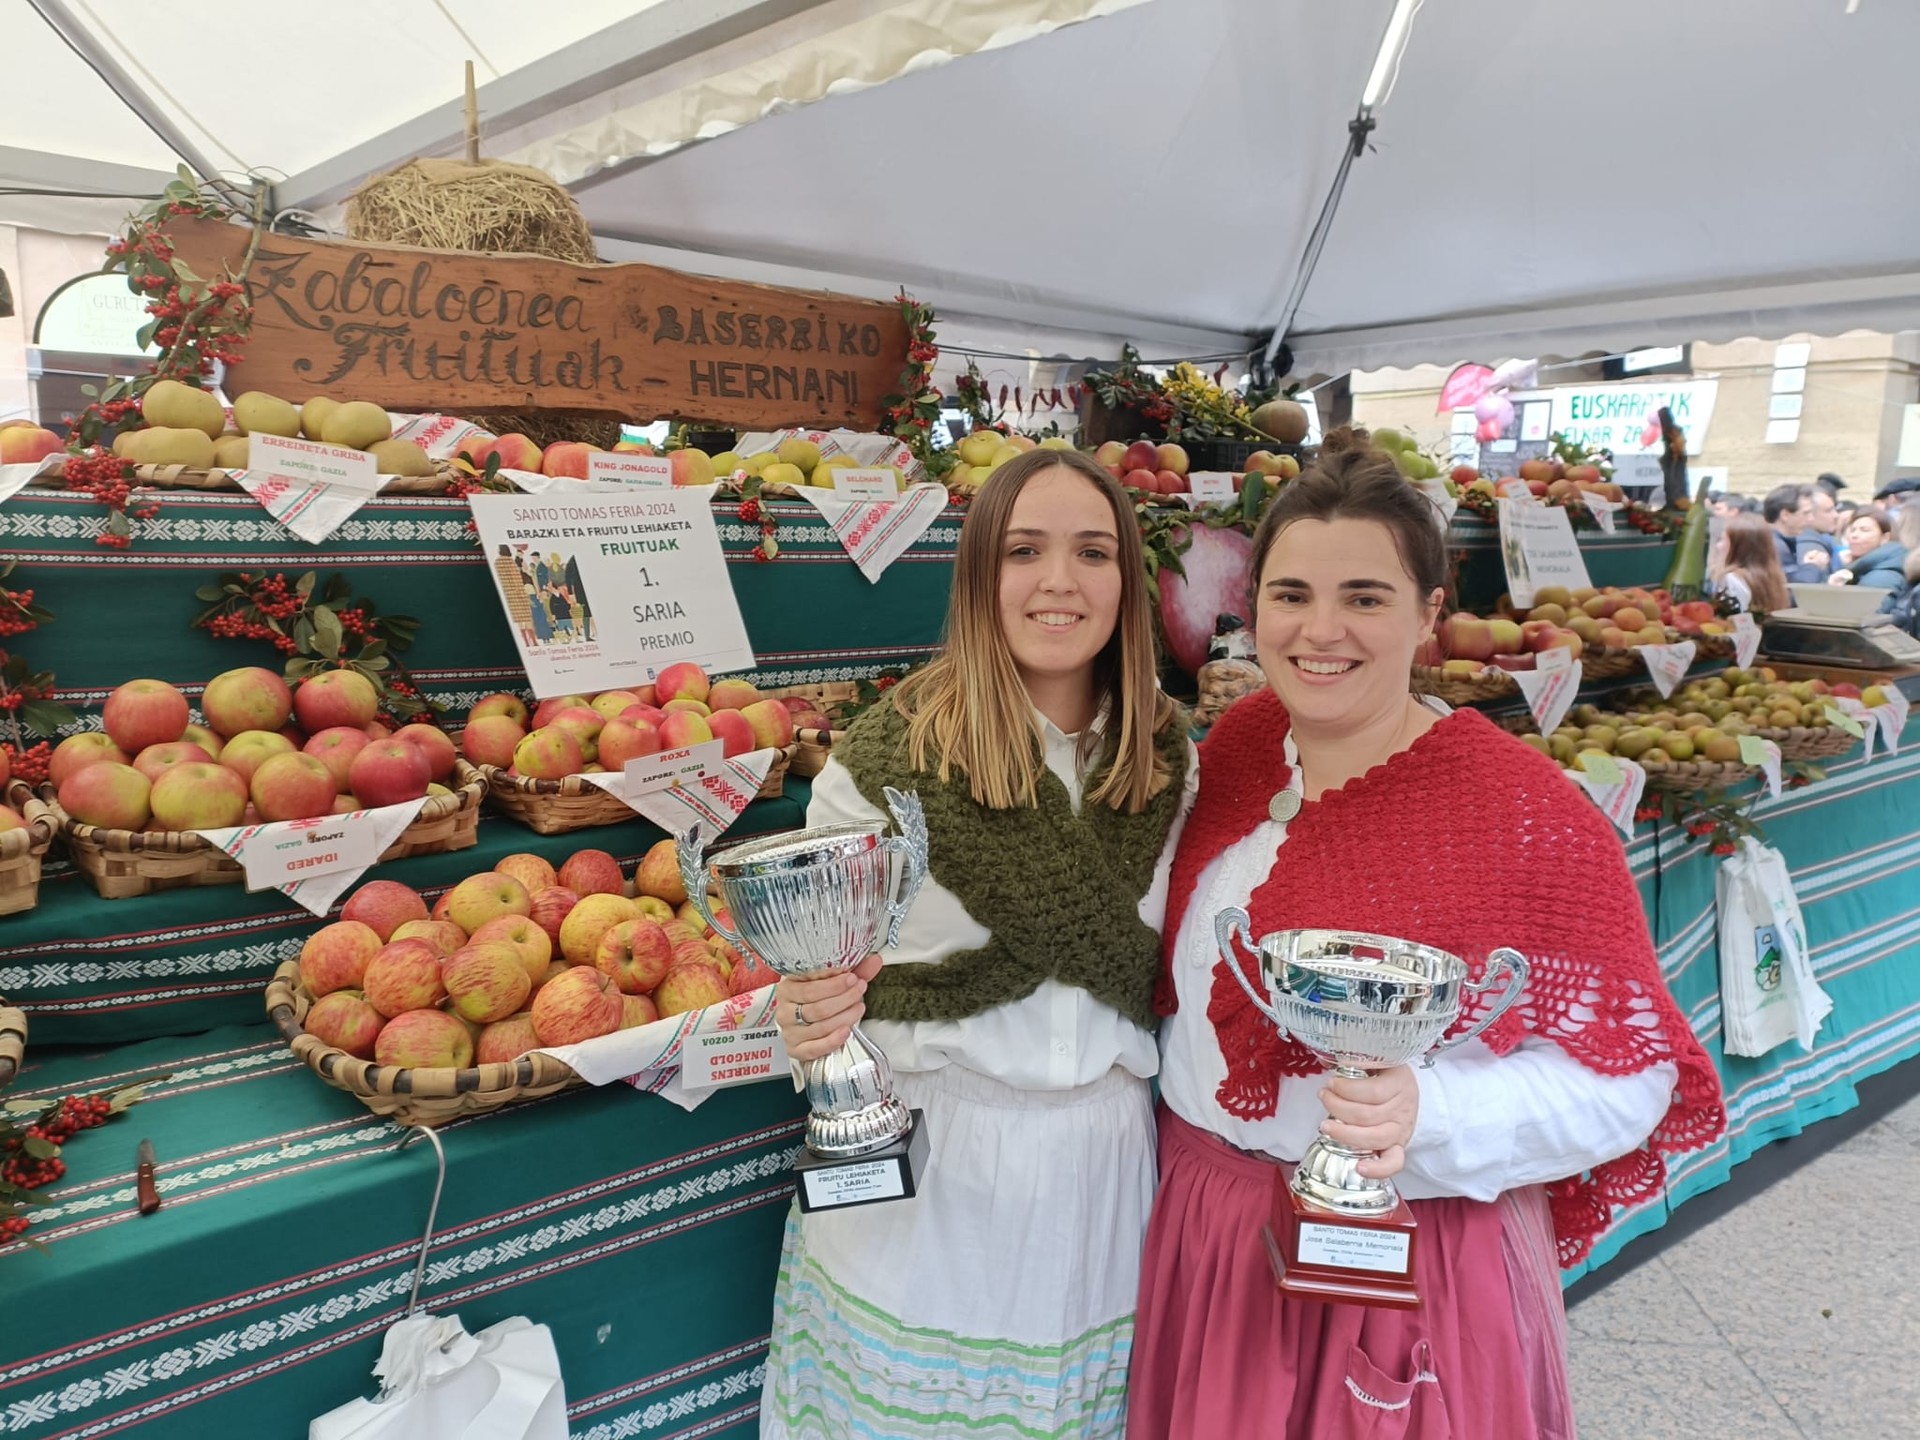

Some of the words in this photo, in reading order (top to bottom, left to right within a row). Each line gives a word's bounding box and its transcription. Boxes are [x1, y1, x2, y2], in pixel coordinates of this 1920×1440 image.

[244, 247, 596, 333] Zabaloenea
[653, 305, 881, 357] BASERRIKO
[689, 359, 859, 407] HERNANI
[262, 436, 328, 455] ERREINETA
[331, 450, 366, 462] GRISA
[594, 462, 617, 470] KING
[619, 464, 668, 474] JONAGOLD
[513, 508, 558, 521] SANTO
[560, 506, 608, 520] TOMAS
[609, 504, 644, 519] FERIA
[646, 503, 676, 516] 2024
[507, 528, 560, 539] BARAZKI
[563, 527, 586, 537] ETA
[588, 525, 628, 537] FRUITU
[631, 521, 692, 534] LEHIAKETA
[600, 538, 680, 556] FRUITUAK
[639, 567, 660, 587] 1.
[633, 601, 686, 623] SARIA
[640, 630, 695, 650] PREMIO
[660, 750, 690, 763] ROXA
[681, 763, 705, 774] GAZIA
[287, 852, 338, 871] IDARED
[702, 1035, 735, 1046] GOZOA
[710, 1046, 773, 1066] JONAGOLD
[711, 1063, 770, 1081] MORRENS
[818, 1174, 844, 1183] FRUITU
[846, 1168, 886, 1180] LEHIAKETA
[844, 1178, 870, 1187] SARIA
